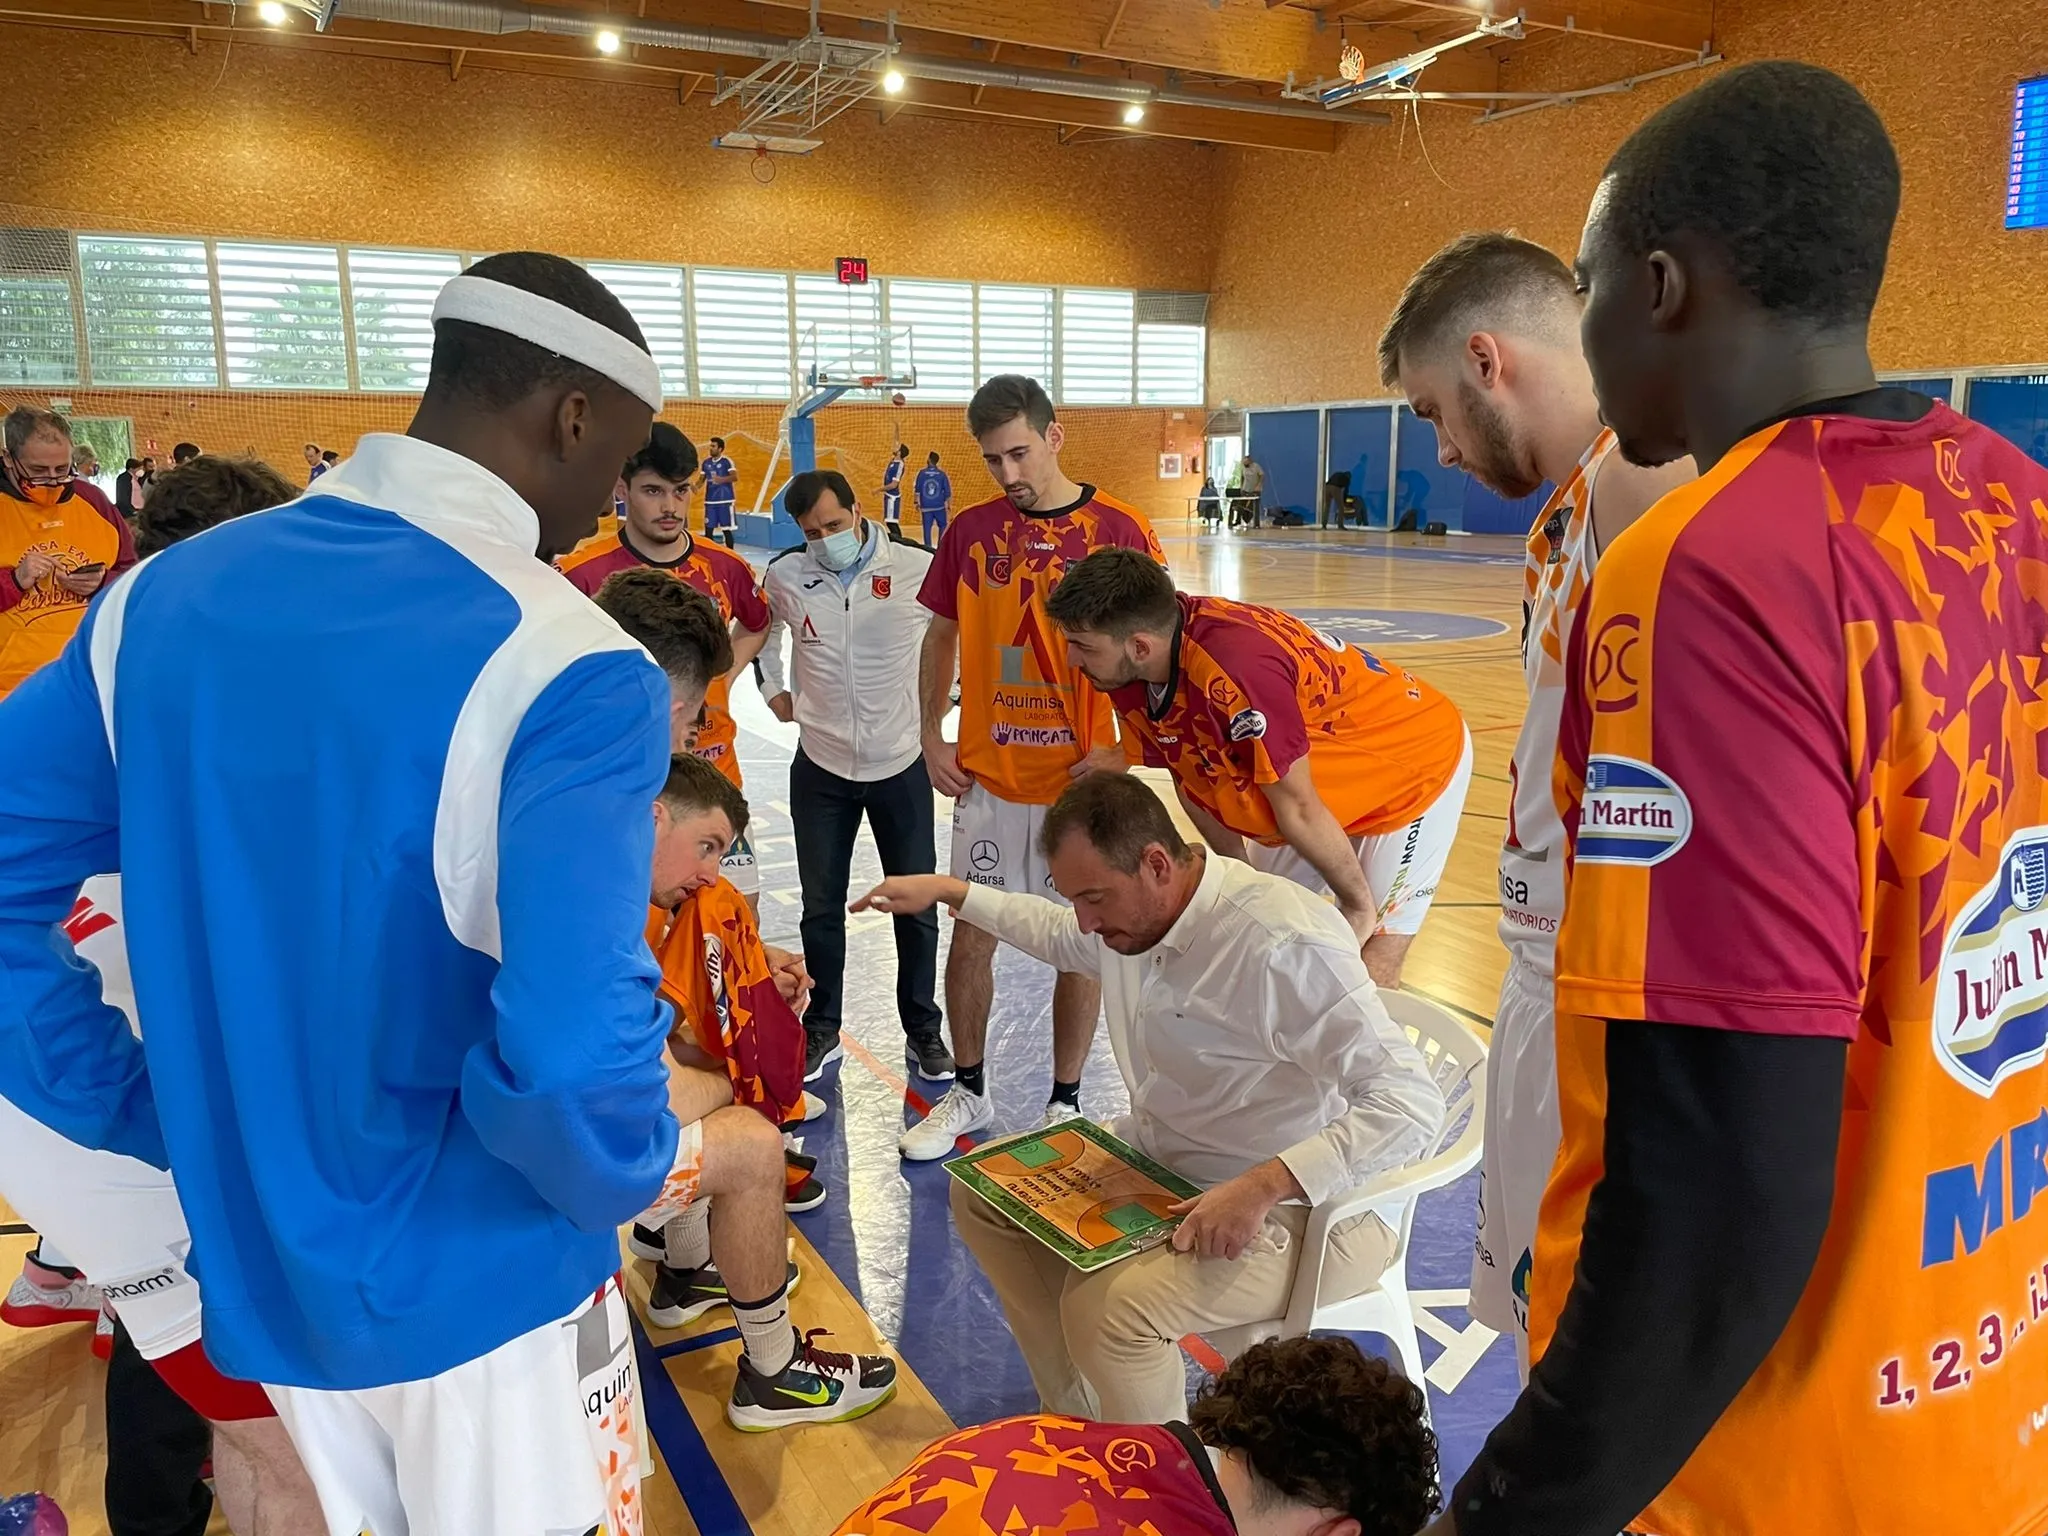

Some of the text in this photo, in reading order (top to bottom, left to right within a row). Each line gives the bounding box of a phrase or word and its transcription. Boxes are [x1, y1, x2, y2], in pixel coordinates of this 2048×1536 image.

[841, 261, 865, 282] 24
[1592, 799, 1674, 829] Martín
[725, 855, 754, 867] ALS
[965, 871, 1005, 886] Adarsa
[1512, 1298, 1528, 1333] AL
